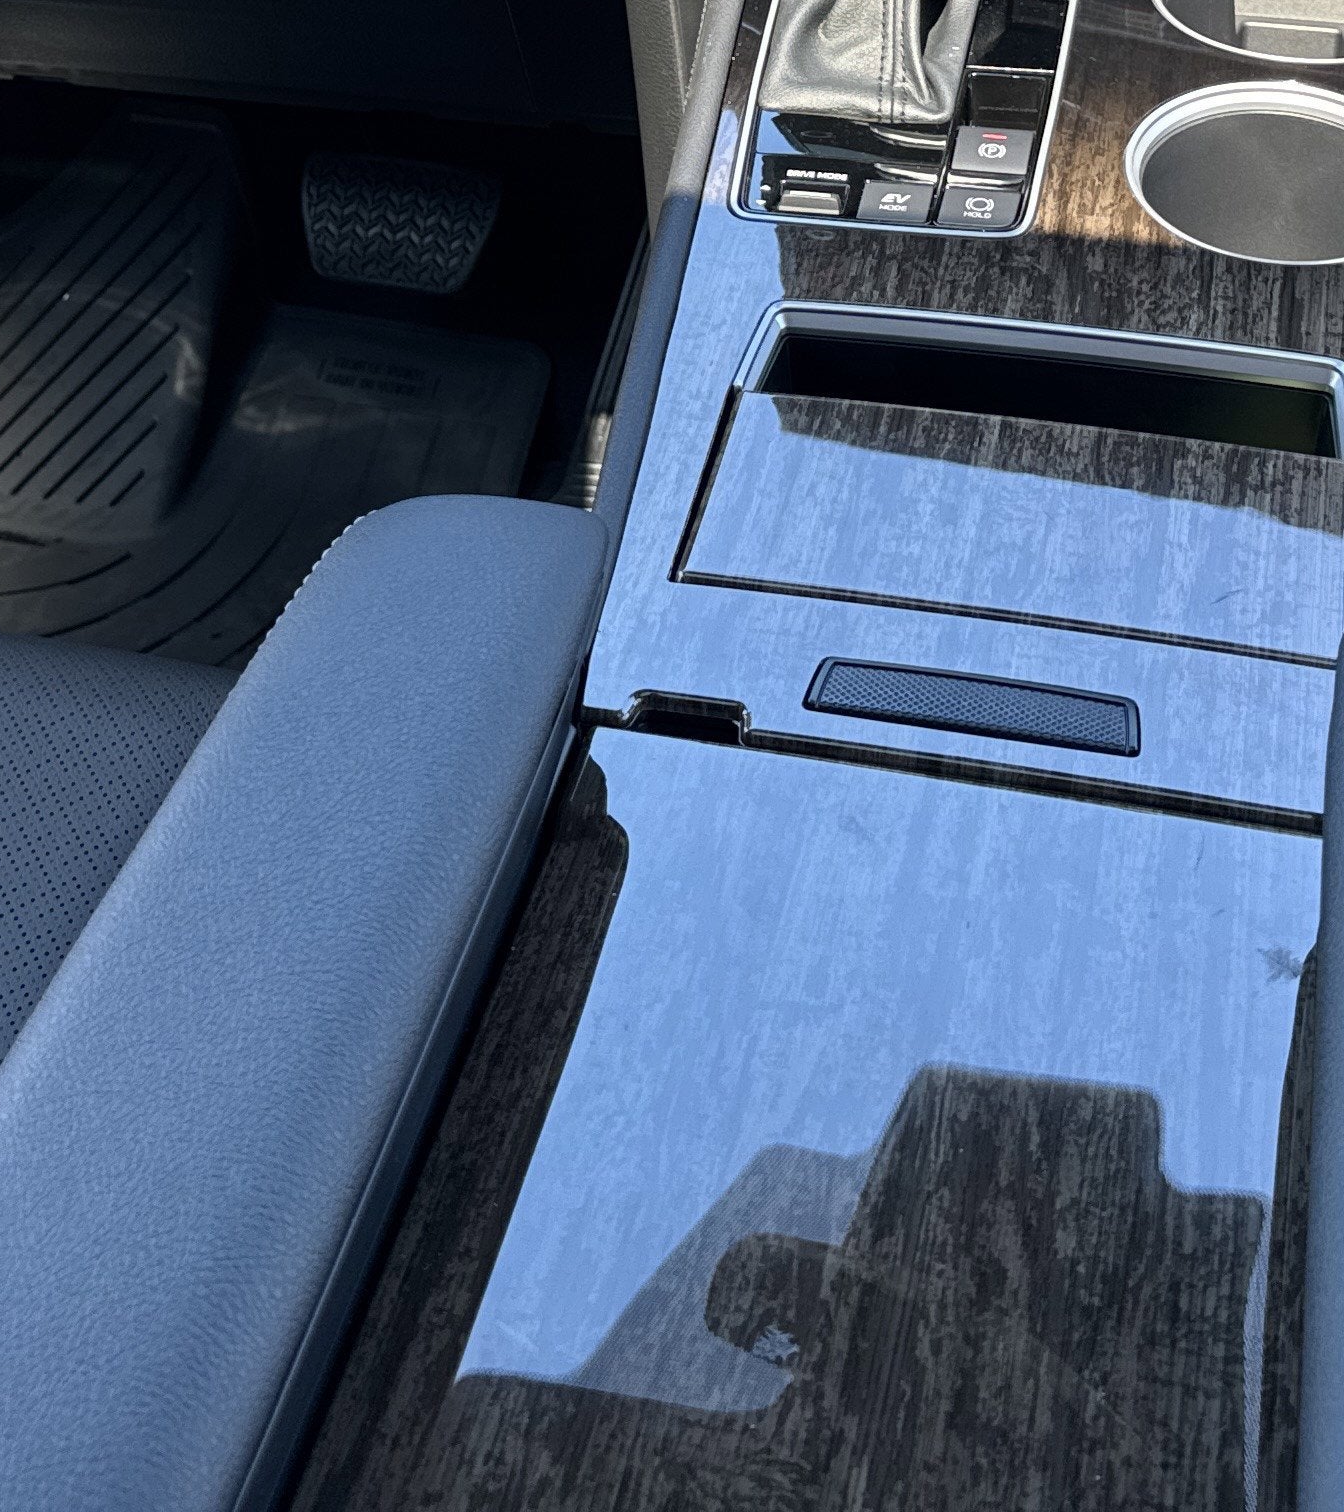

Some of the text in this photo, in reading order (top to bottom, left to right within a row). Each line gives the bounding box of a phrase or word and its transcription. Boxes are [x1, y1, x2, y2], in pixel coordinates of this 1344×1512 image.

[786, 168, 848, 182] DRIVE MODE
[880, 193, 912, 204] EV
[879, 203, 908, 212] MODE
[963, 210, 992, 220] HOLD
